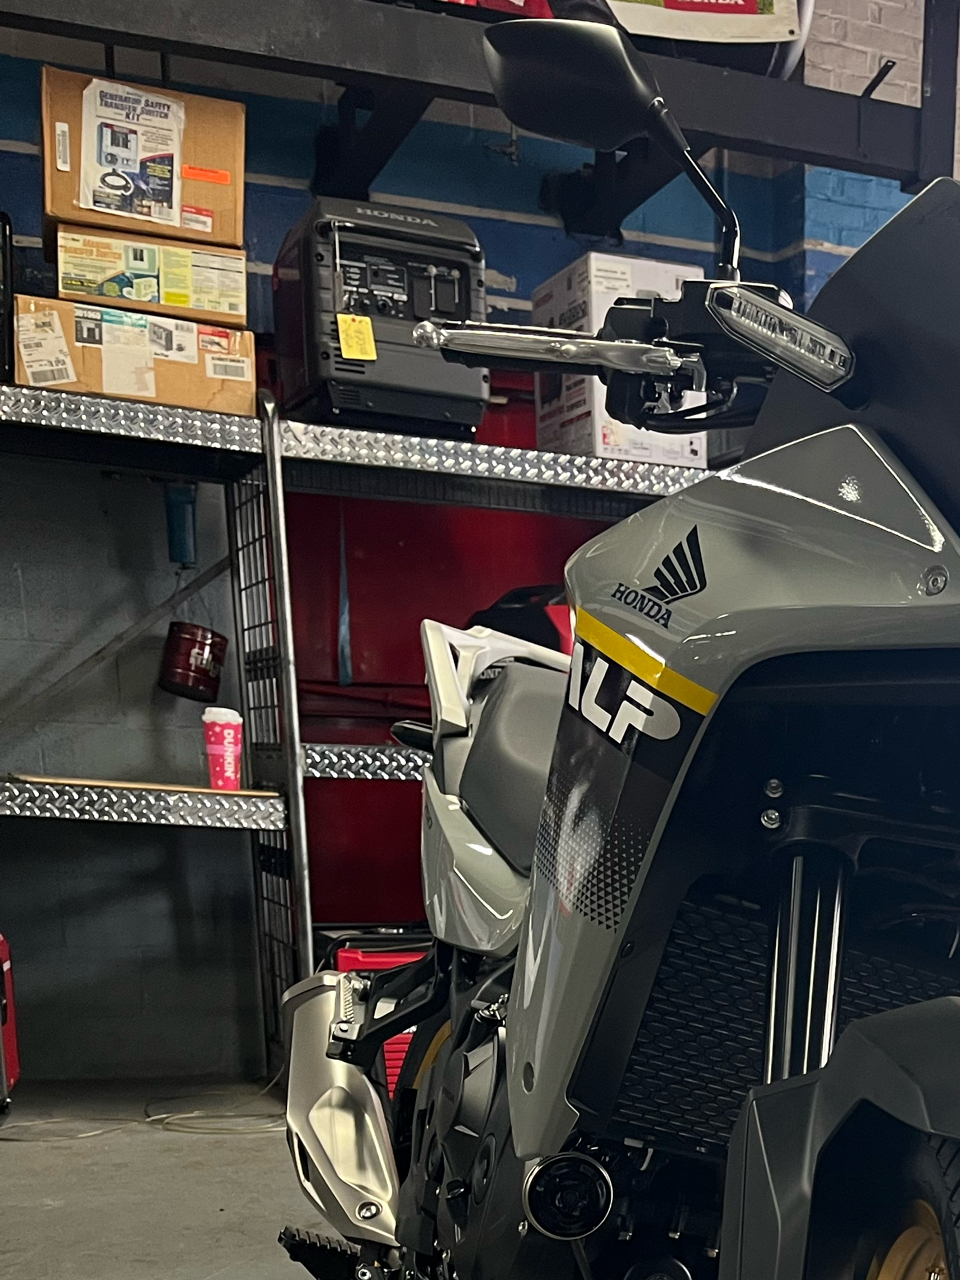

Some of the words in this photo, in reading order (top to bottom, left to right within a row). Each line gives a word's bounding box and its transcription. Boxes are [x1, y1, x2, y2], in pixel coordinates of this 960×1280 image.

[143, 99, 171, 111] SAFETY
[125, 111, 141, 122] KIT
[355, 207, 439, 227] HONDA
[611, 582, 672, 629] HONDA
